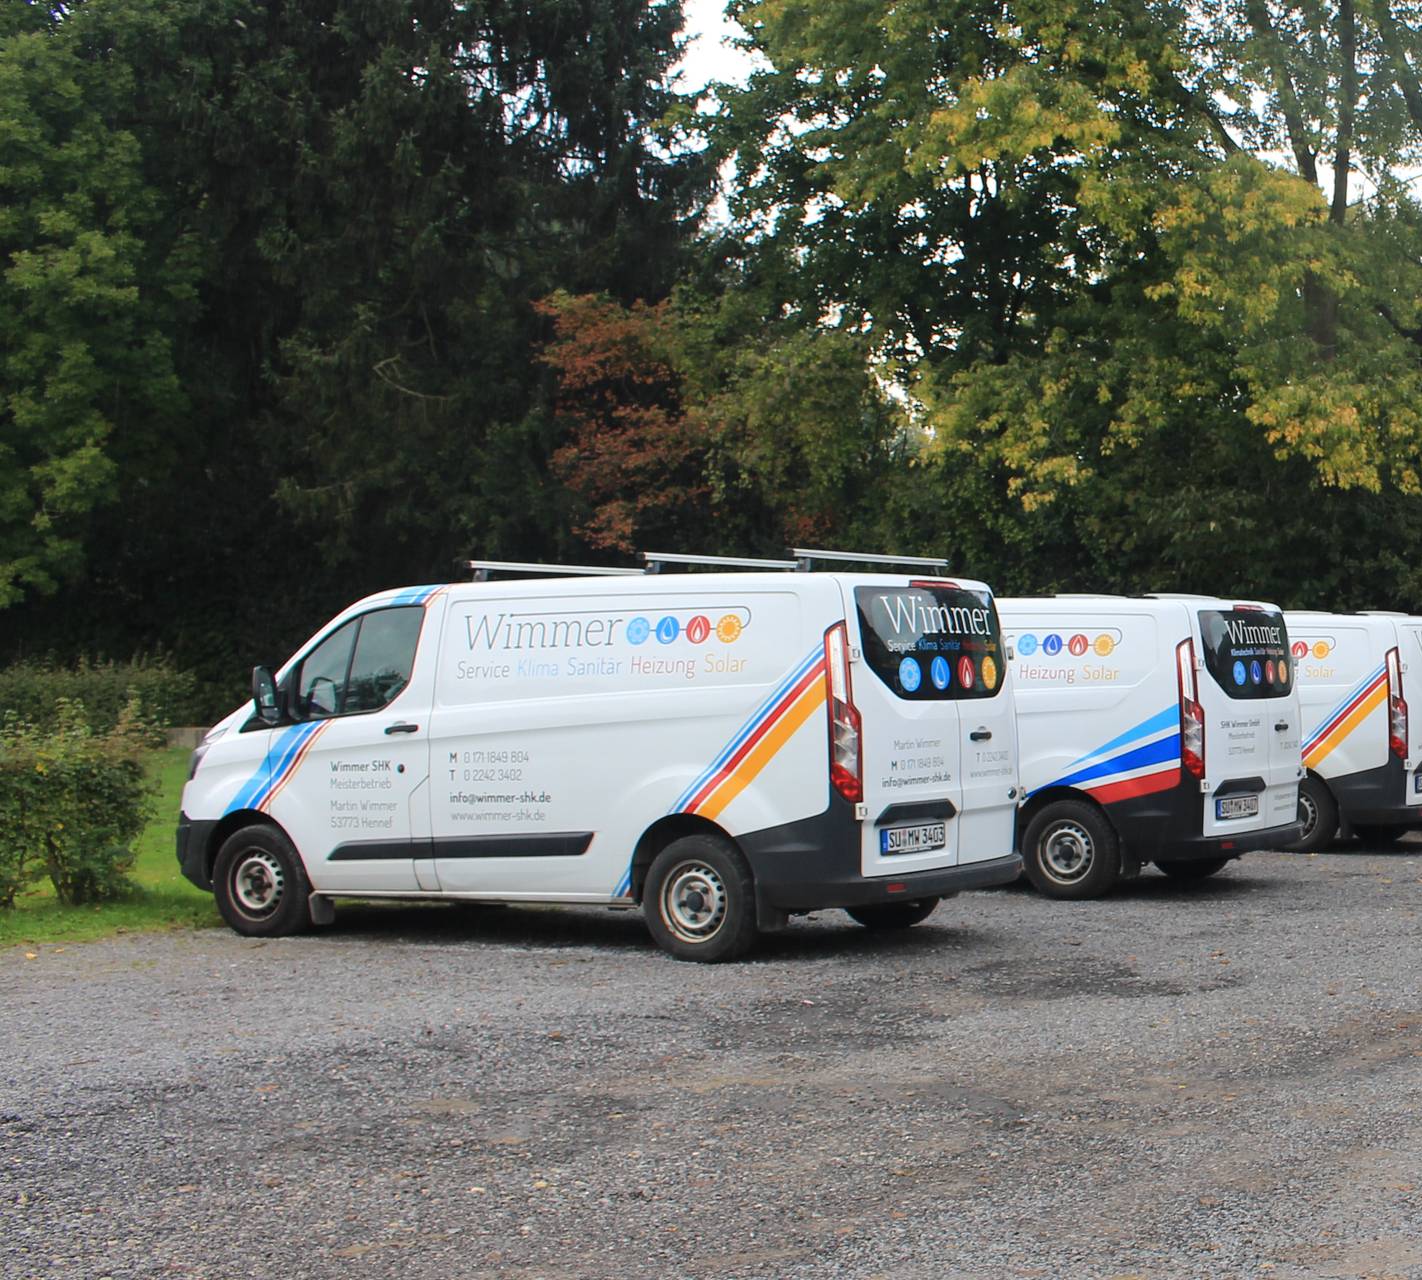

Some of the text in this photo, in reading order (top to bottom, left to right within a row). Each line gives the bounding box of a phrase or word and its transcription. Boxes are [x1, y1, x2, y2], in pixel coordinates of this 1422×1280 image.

[880, 596, 991, 635] Wimmer
[464, 613, 623, 651] Wimmer
[1224, 620, 1281, 644] Wimmer
[456, 653, 748, 681] Service Klima Sanitär Heizung Solar
[1020, 663, 1119, 684] Heizung Solar
[1305, 665, 1336, 679] Solar
[450, 752, 457, 763] M
[330, 760, 391, 773] Wimmer SHK
[450, 770, 456, 781] T
[472, 769, 498, 781] 2242
[499, 769, 522, 781] 3402
[330, 777, 392, 790] Meisterbetrieb
[450, 791, 551, 805] info@wimmer-shk.de
[330, 799, 398, 812] Martin Wimmer
[451, 807, 546, 821] www.wimmer-shk.de
[330, 816, 393, 829] 53773 Hennef
[889, 826, 944, 849] SU MW 3403
